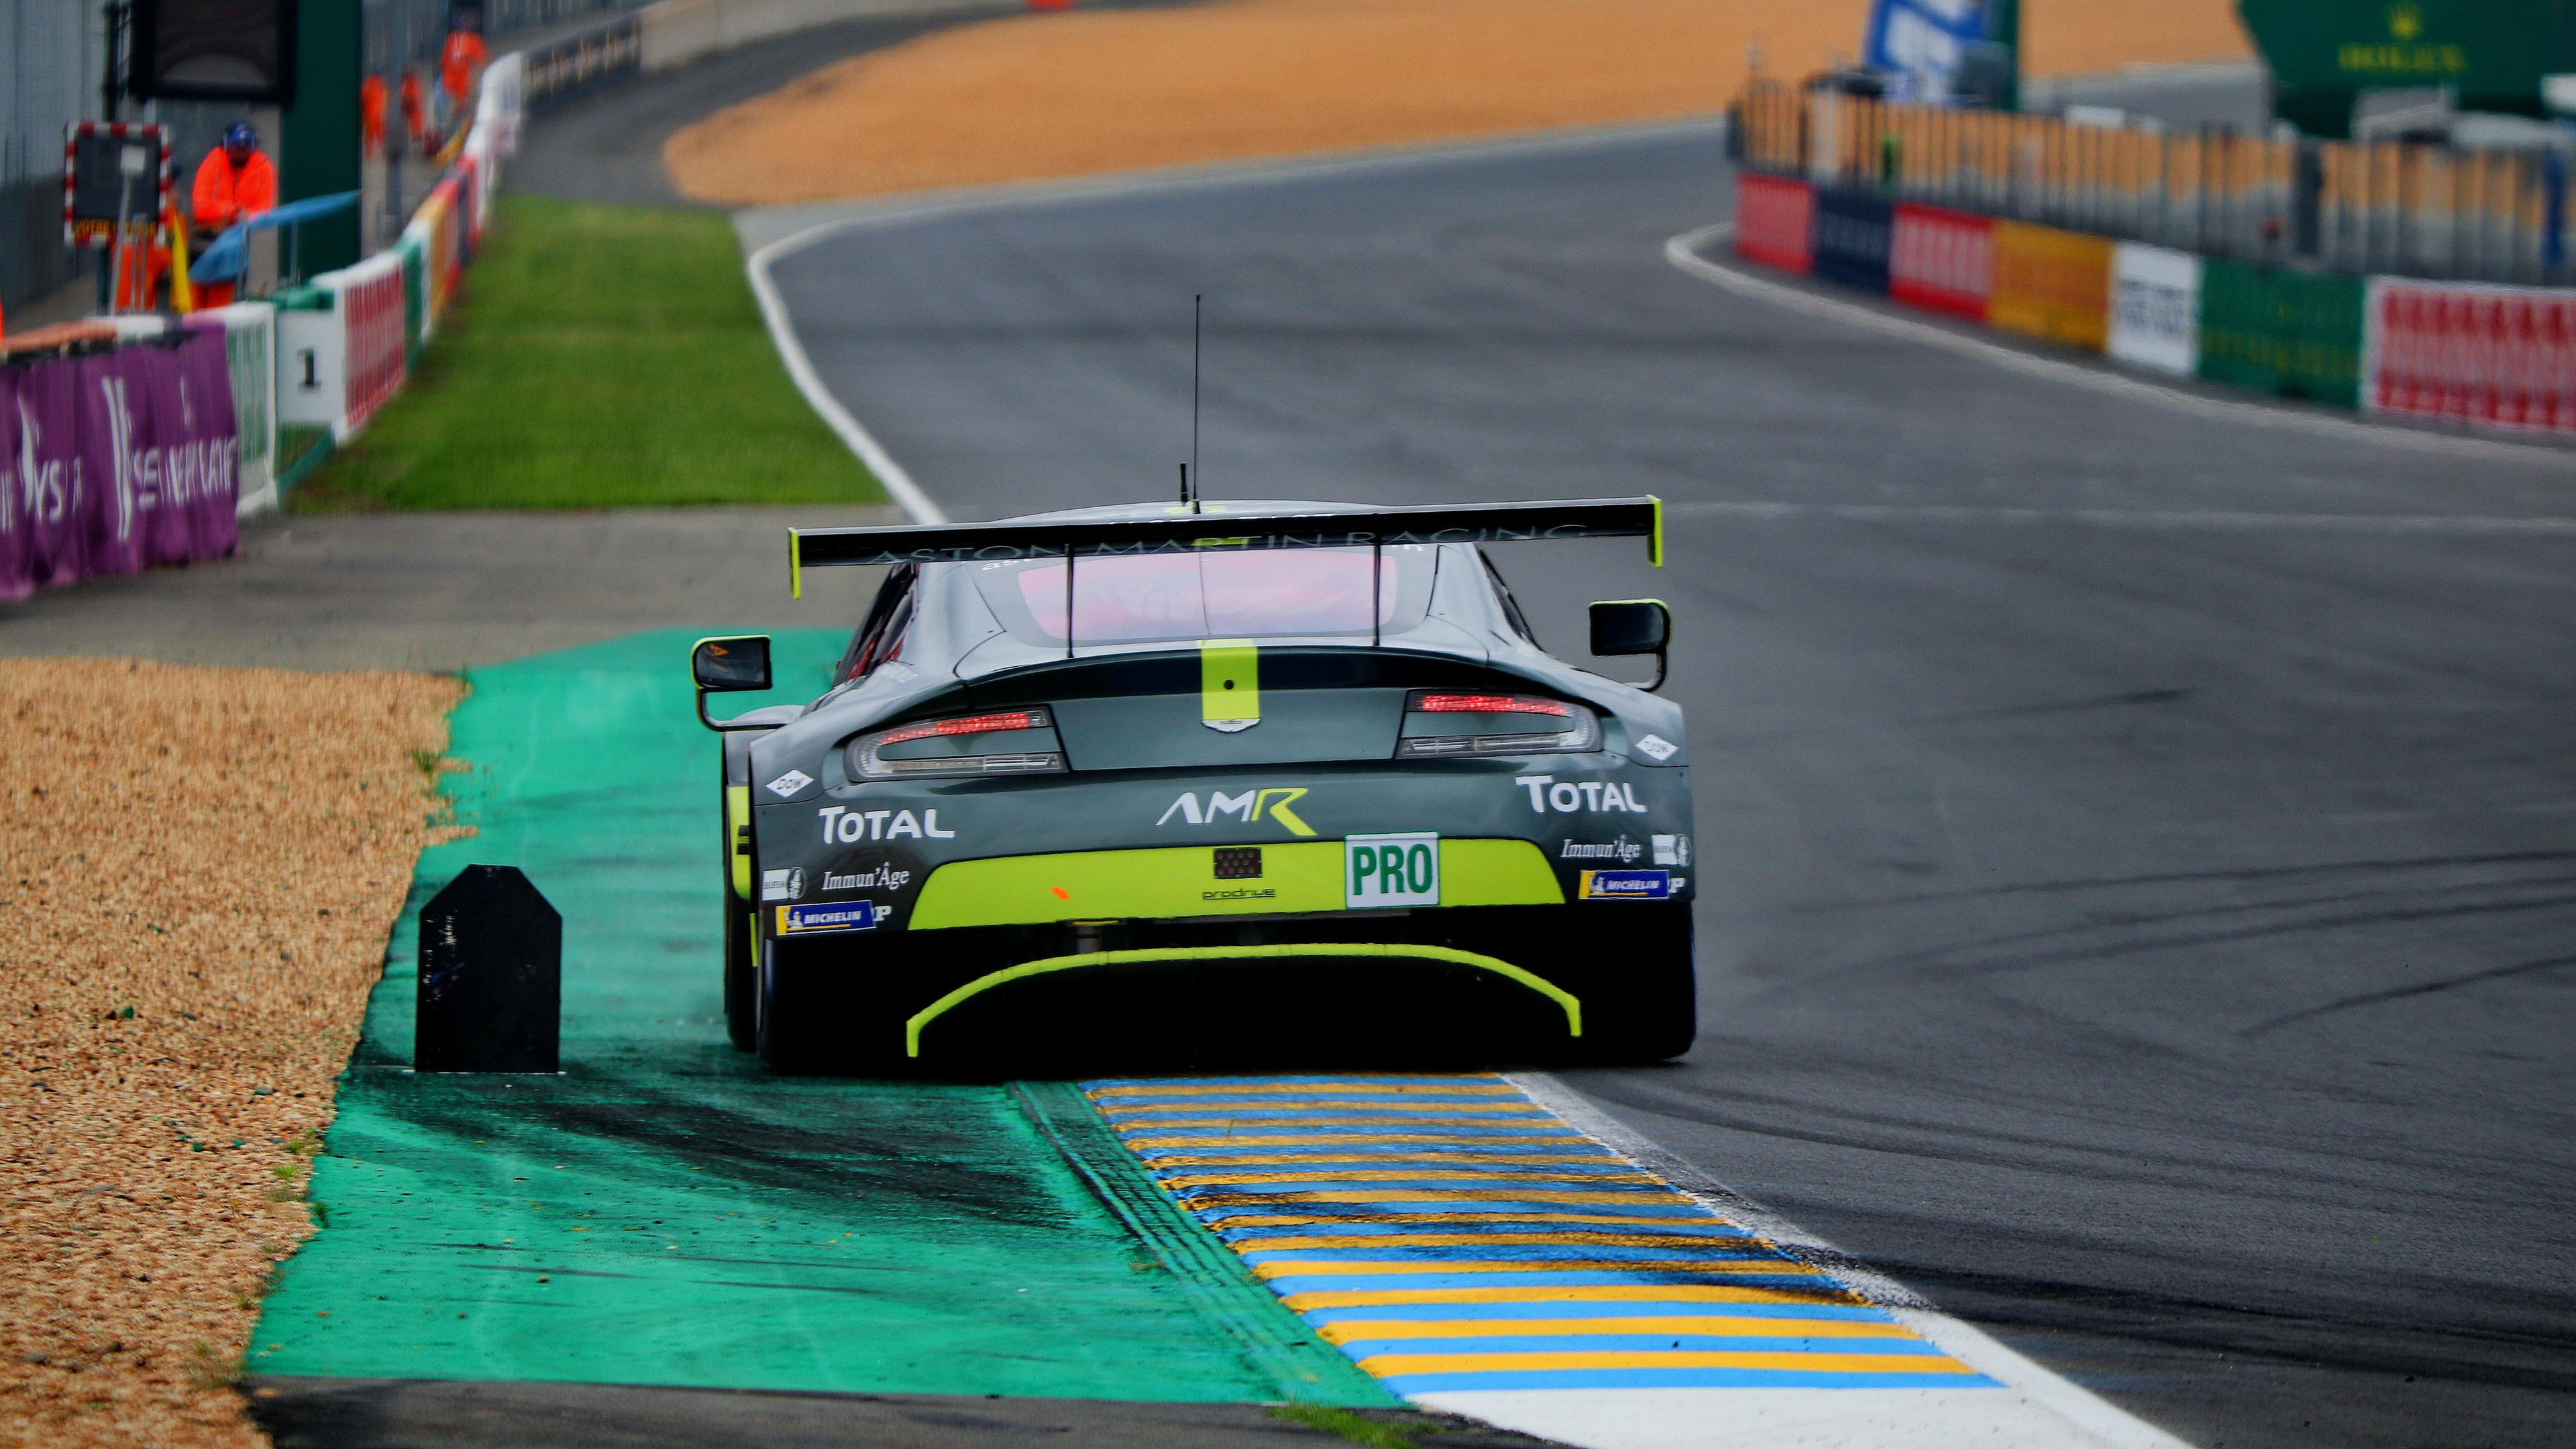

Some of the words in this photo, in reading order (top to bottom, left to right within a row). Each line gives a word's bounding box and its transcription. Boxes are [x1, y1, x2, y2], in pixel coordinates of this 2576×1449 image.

[297, 349, 321, 389] 1
[869, 543, 1071, 564] ASTON
[1347, 524, 1587, 546] RACING
[1155, 788, 1318, 837] AMR
[1514, 774, 1648, 813] TOTAL
[818, 805, 955, 845] TOTAL
[1352, 843, 1433, 896] PRO
[1605, 880, 1660, 891] MICHELIN
[1203, 888, 1275, 900] prodrive
[803, 910, 863, 924] MICHELIN
